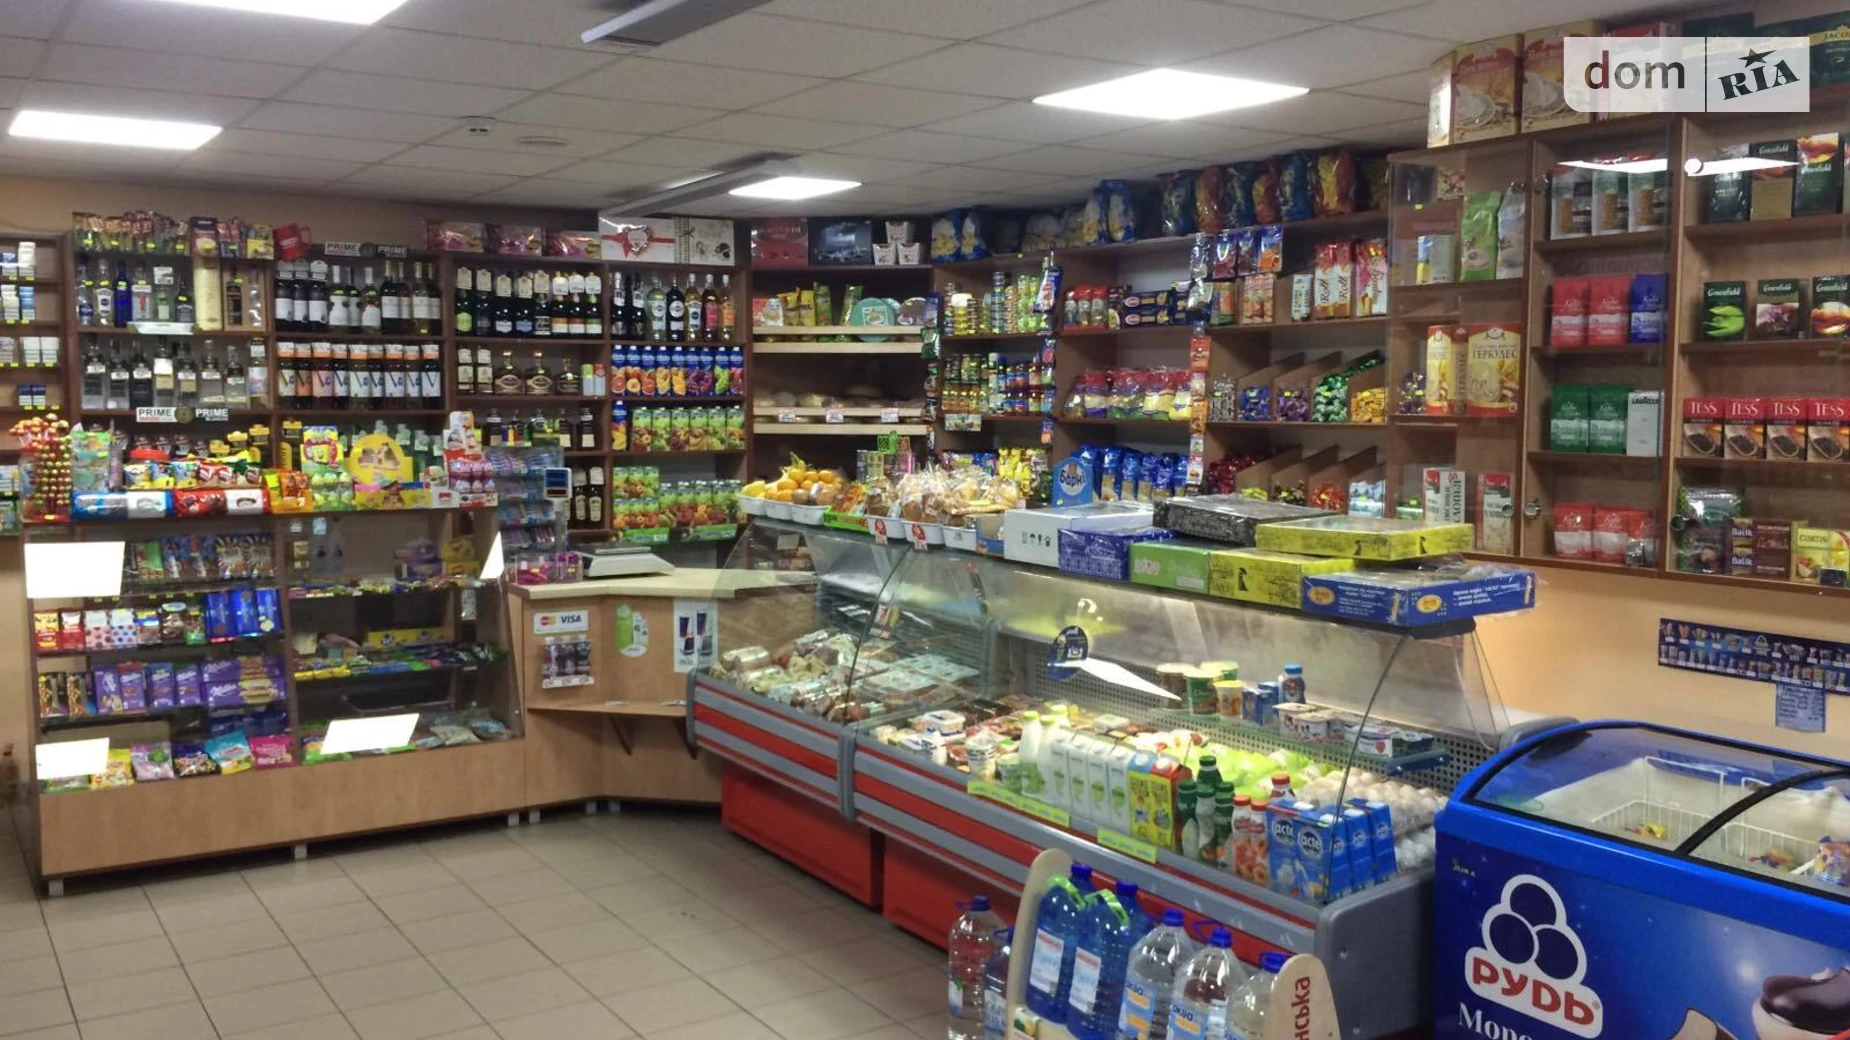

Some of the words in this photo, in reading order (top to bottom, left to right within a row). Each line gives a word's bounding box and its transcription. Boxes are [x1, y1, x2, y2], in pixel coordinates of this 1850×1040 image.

[1707, 286, 1741, 297] Greenfield
[1472, 349, 1517, 360] ГЕРКУЛЕС
[139, 408, 173, 417] PRIME
[195, 408, 229, 418] PRIME
[1690, 401, 1718, 415] TESS
[1732, 402, 1759, 417] TESS
[1774, 402, 1800, 417] TESS
[1814, 402, 1845, 418] TESS
[1059, 468, 1087, 488] Барні
[560, 615, 582, 624] VISA
[1472, 956, 1594, 1025] РУДЬ
